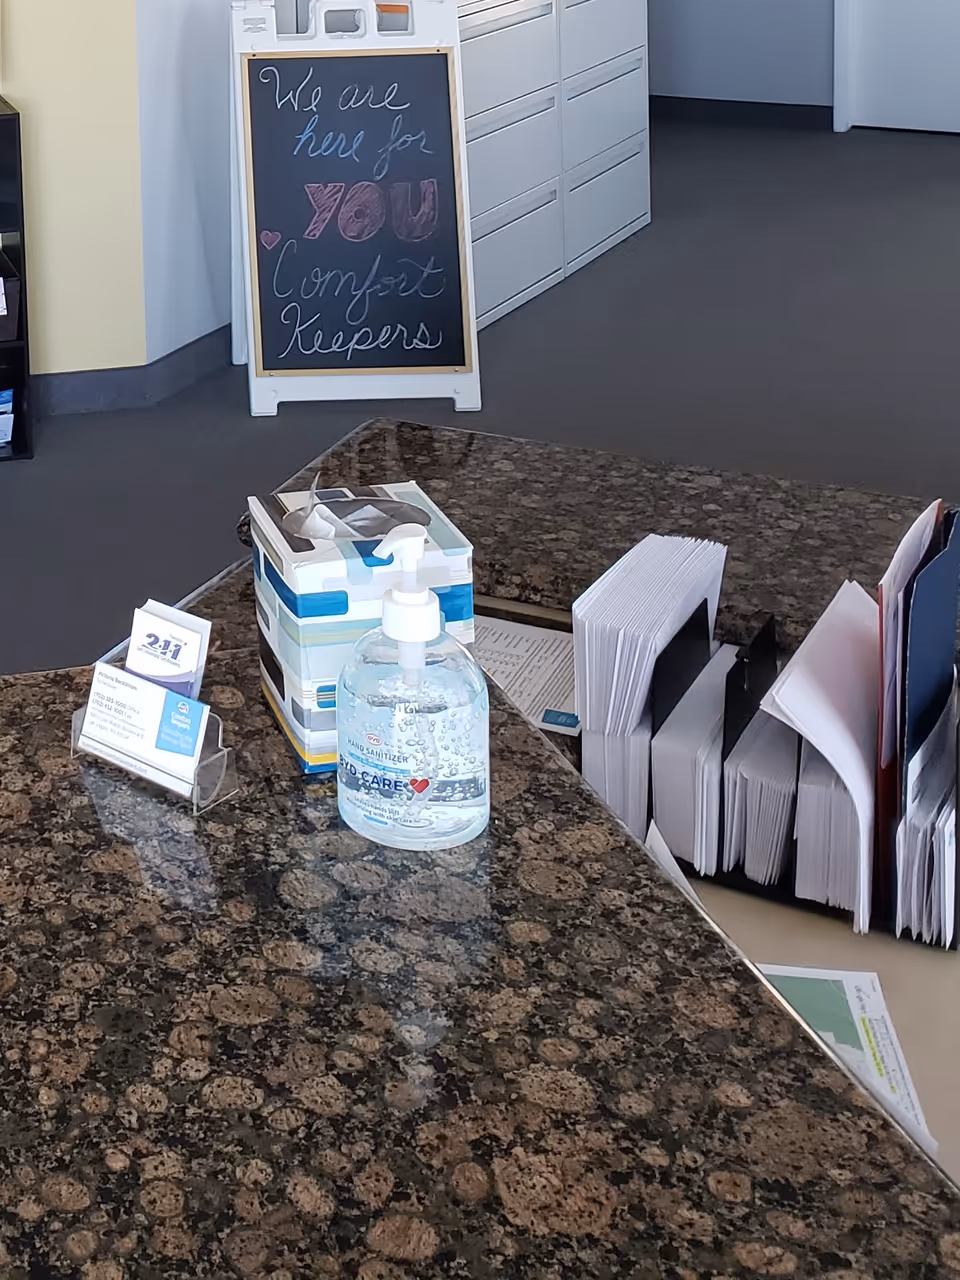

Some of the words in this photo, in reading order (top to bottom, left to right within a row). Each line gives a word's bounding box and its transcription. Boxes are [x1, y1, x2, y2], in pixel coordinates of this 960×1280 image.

[259, 66, 322, 112] We
[338, 82, 411, 111] are
[293, 114, 365, 163] here
[373, 114, 435, 180] for
[303, 178, 439, 242] YOU
[272, 239, 447, 325] Comfort
[278, 302, 443, 361] Keepers
[347, 738, 365, 752] HAND
[365, 747, 409, 764] SANITIZER
[361, 771, 404, 792] CARE
